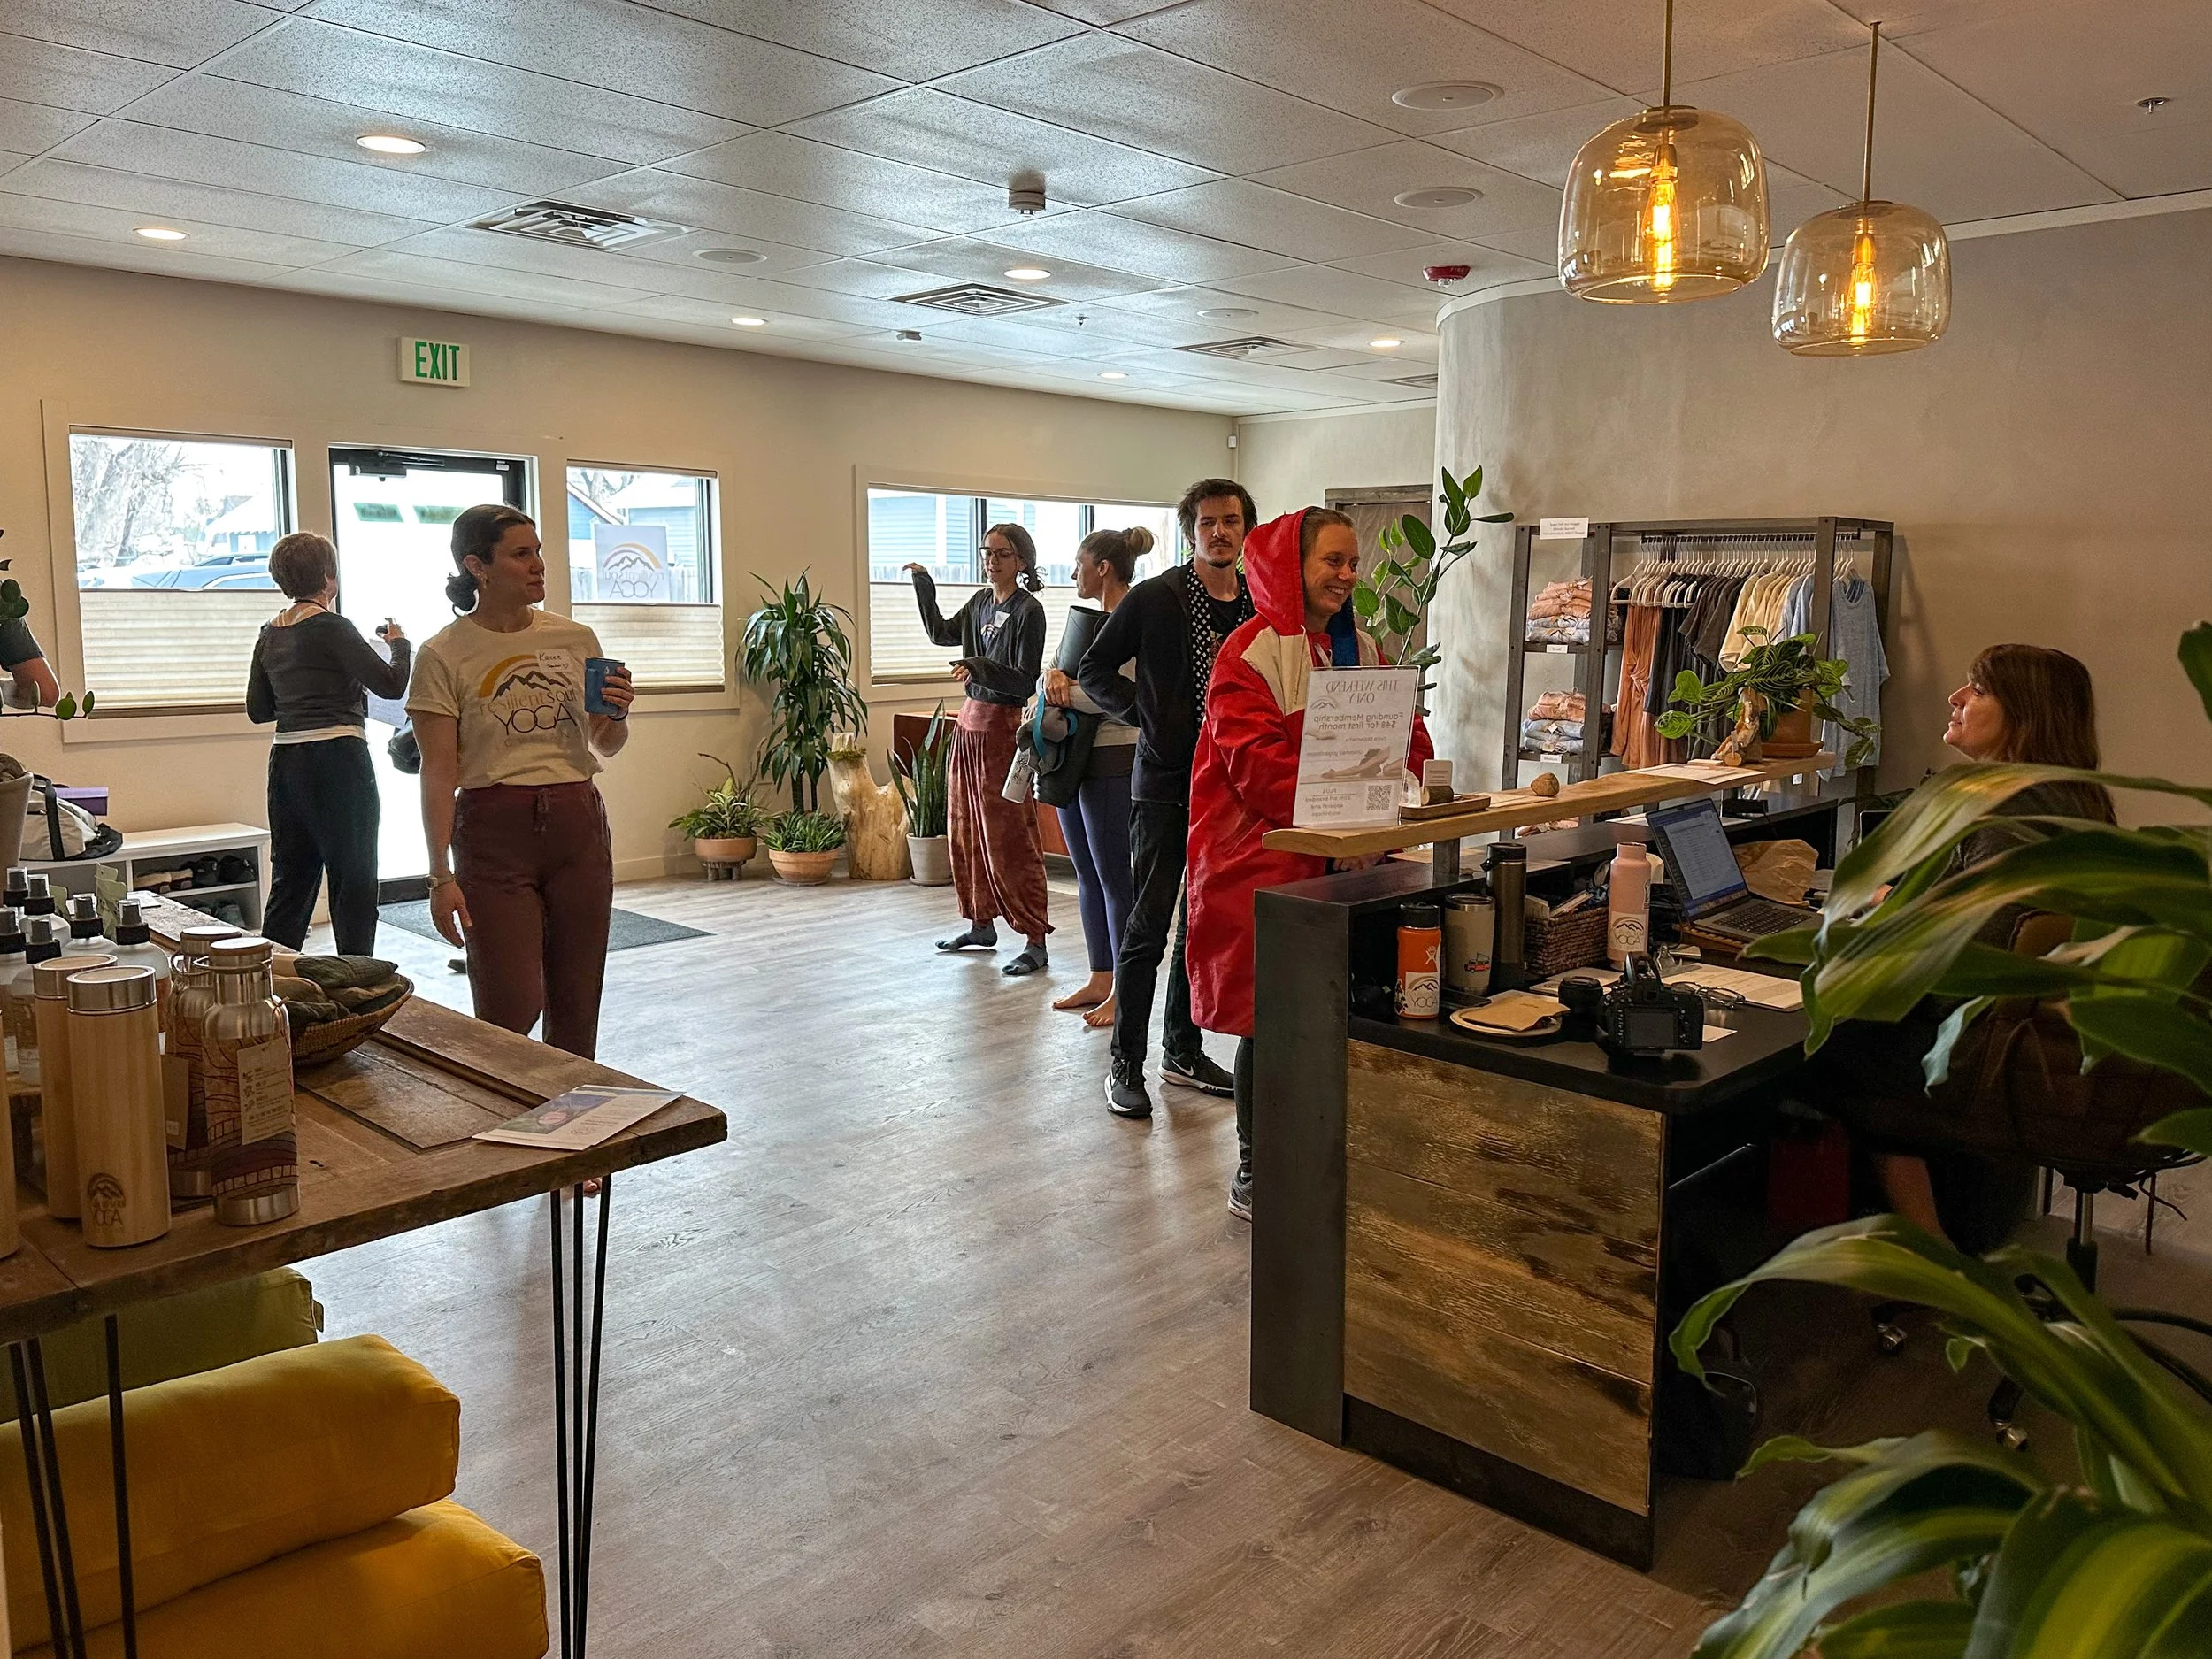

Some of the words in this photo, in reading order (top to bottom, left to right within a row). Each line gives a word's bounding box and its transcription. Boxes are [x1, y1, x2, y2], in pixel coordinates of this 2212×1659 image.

[415, 341, 460, 380] EXIT
[493, 703, 578, 735] YOGA
[1614, 933, 1641, 946] YOGA
